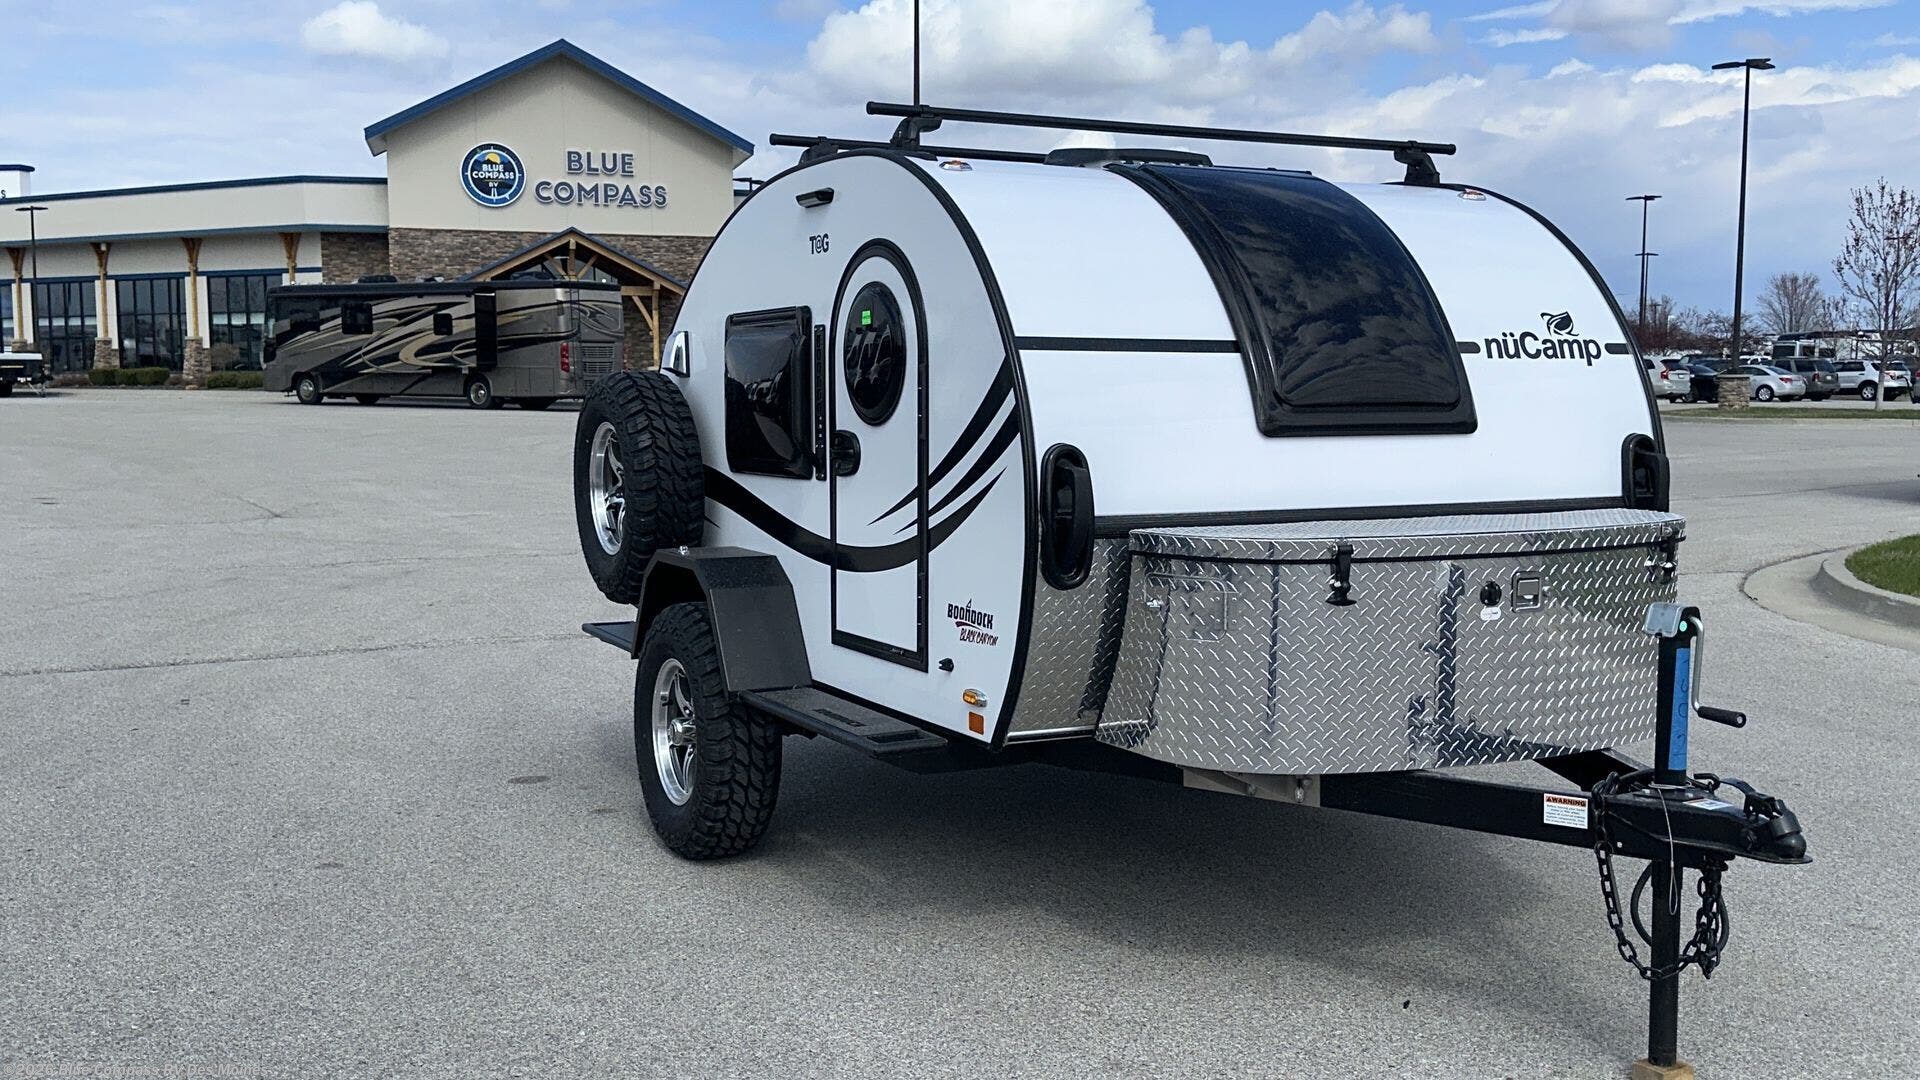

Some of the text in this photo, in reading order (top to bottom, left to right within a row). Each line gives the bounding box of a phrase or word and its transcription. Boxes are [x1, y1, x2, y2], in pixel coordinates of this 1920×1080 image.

[472, 170, 515, 180] COMPASS
[482, 163, 505, 172] BLUE
[566, 150, 635, 176] BLUE
[534, 180, 668, 208] COMPASS
[809, 233, 830, 255] T@G
[1484, 331, 1602, 366] nüCamp
[947, 602, 994, 630] BOONDOCK
[1552, 796, 1585, 807] WARNING
